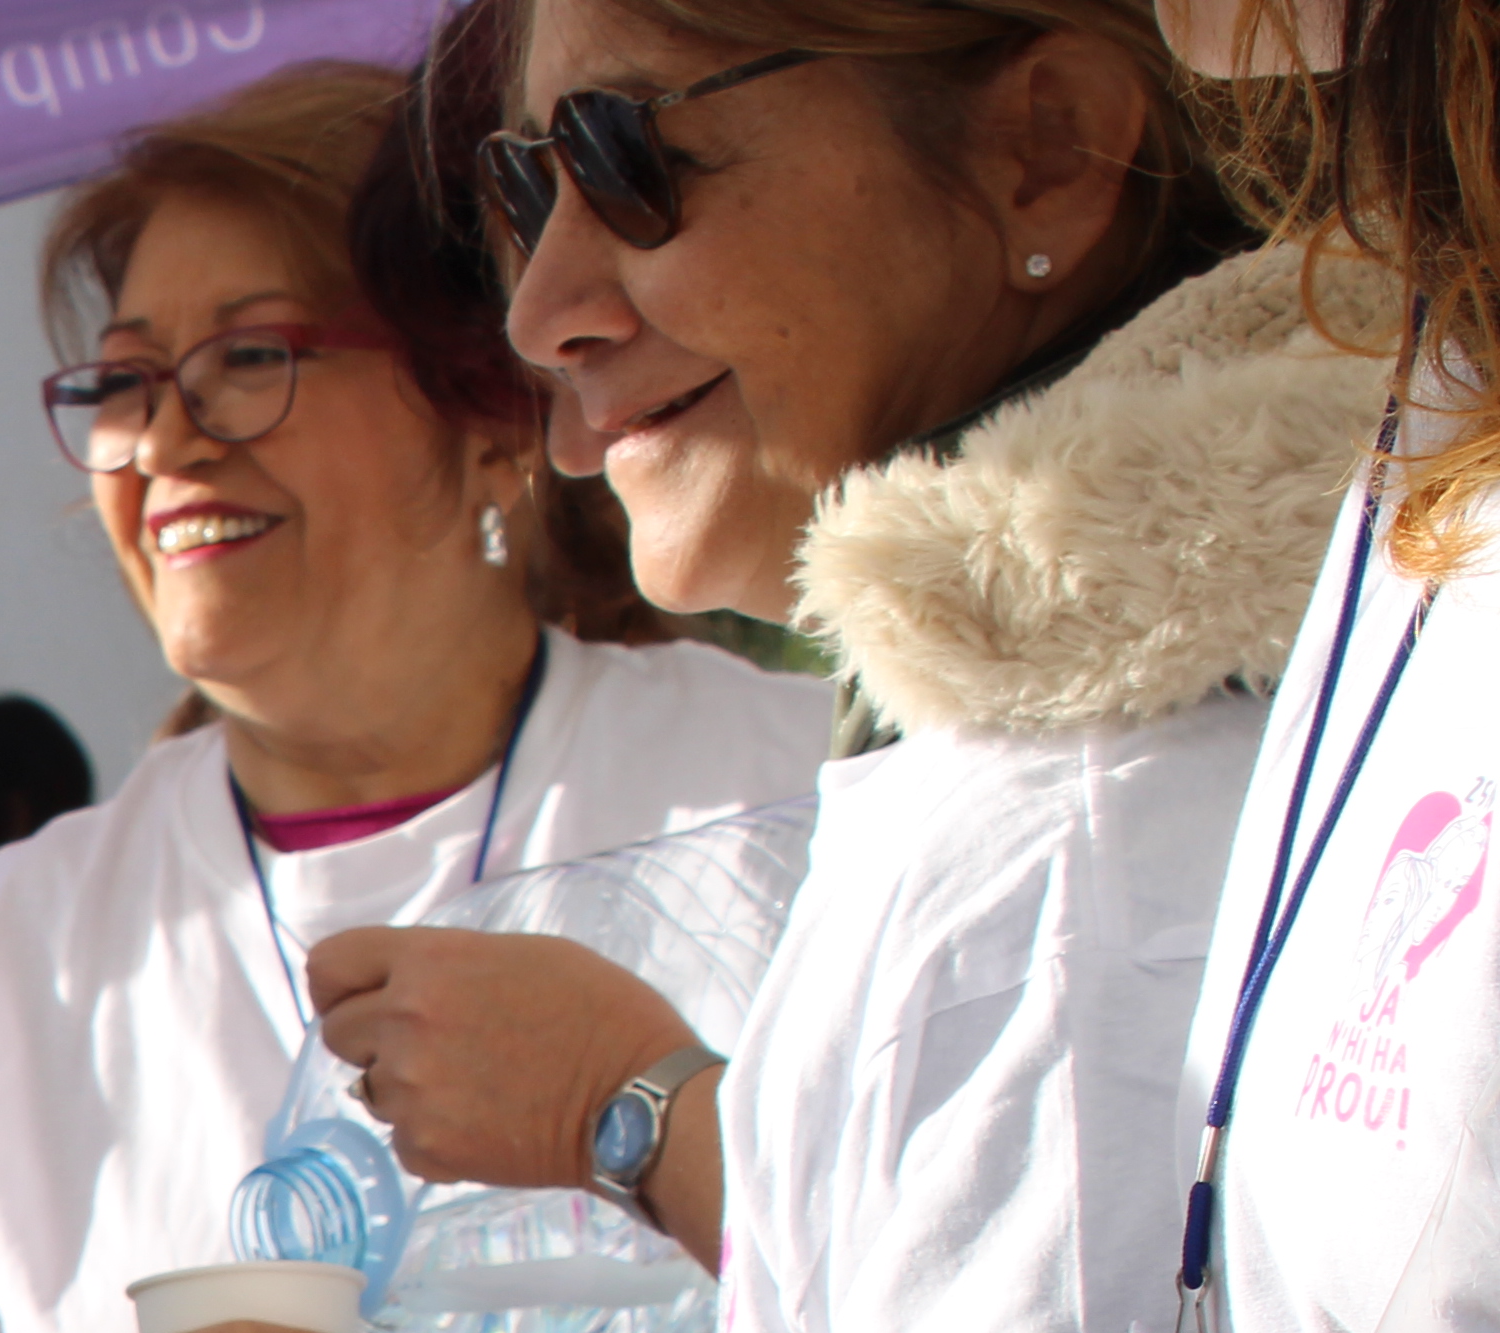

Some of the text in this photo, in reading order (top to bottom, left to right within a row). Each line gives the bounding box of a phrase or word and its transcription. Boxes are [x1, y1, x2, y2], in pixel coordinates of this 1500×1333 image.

[1359, 975, 1400, 1027] JA
[1370, 1036, 1407, 1075] HA
[1295, 1053, 1411, 1151] PROU!
